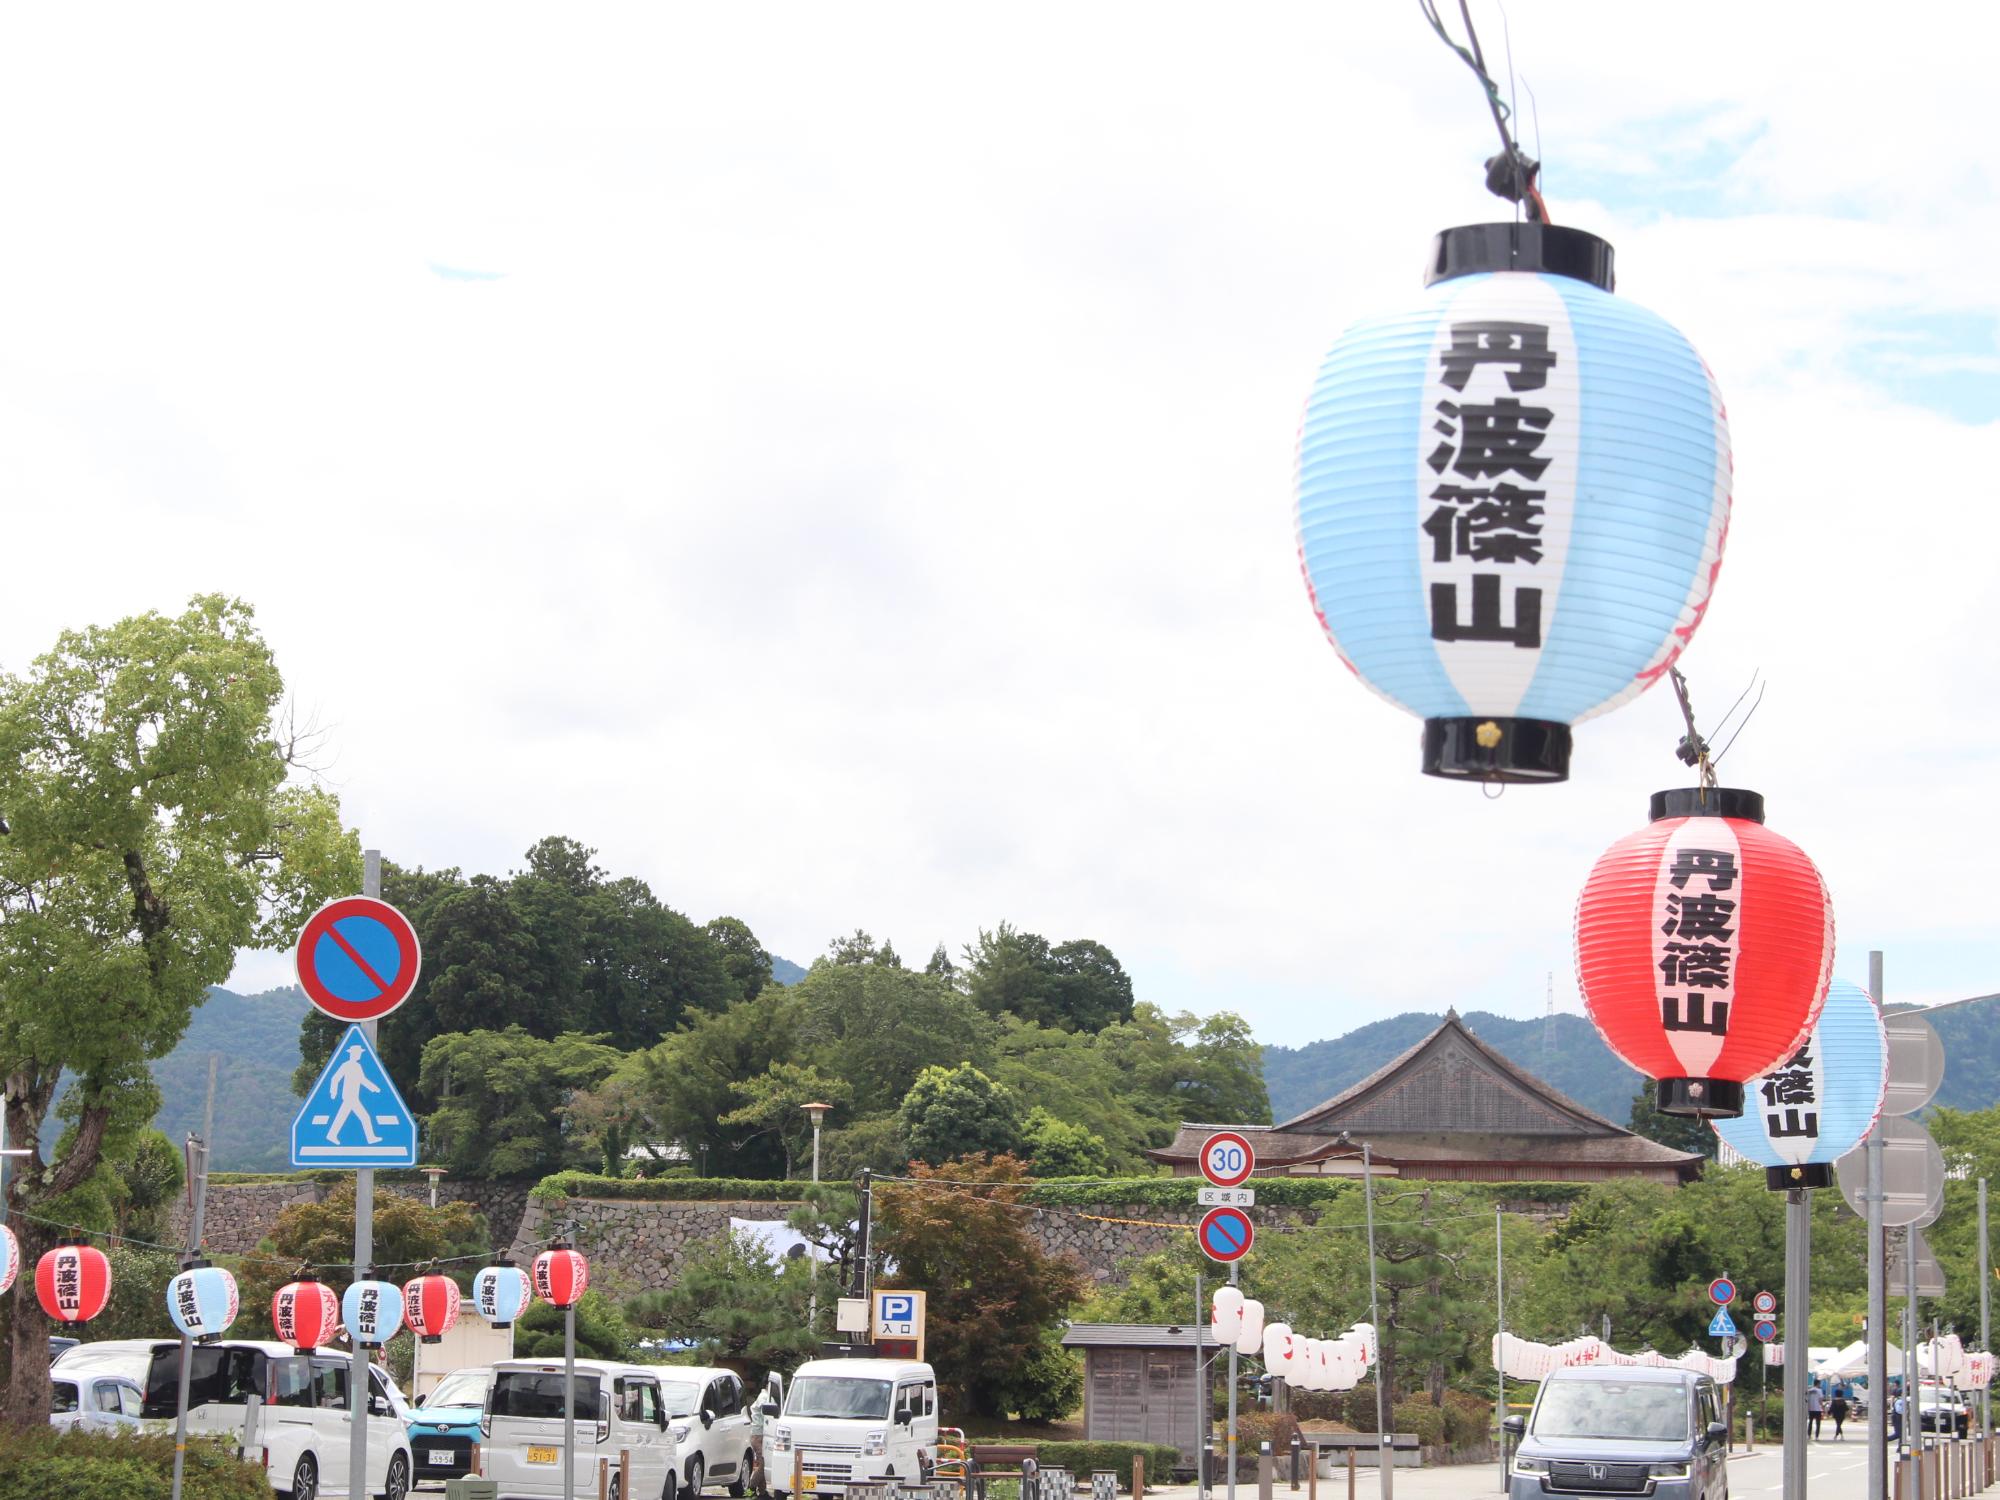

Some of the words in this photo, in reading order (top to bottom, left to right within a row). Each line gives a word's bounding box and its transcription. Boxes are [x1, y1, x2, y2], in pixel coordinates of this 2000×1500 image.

[1422, 321, 1556, 648] 丹波篠山
[1658, 848, 1738, 1037] 丹波篠山
[1212, 1148, 1242, 1172] 30
[1204, 1191, 1248, 1203] 区域内
[57, 1256, 79, 1310] 丹波篠山
[177, 1278, 202, 1327] 丹波篠山
[407, 1283, 424, 1327] 丹波篠山
[481, 1275, 497, 1316] 丹波篠山
[279, 1293, 297, 1340] 丹波篠山
[359, 1289, 379, 1334] 丹波篠山
[882, 1323, 911, 1334] 入口
[885, 1298, 909, 1320] P
